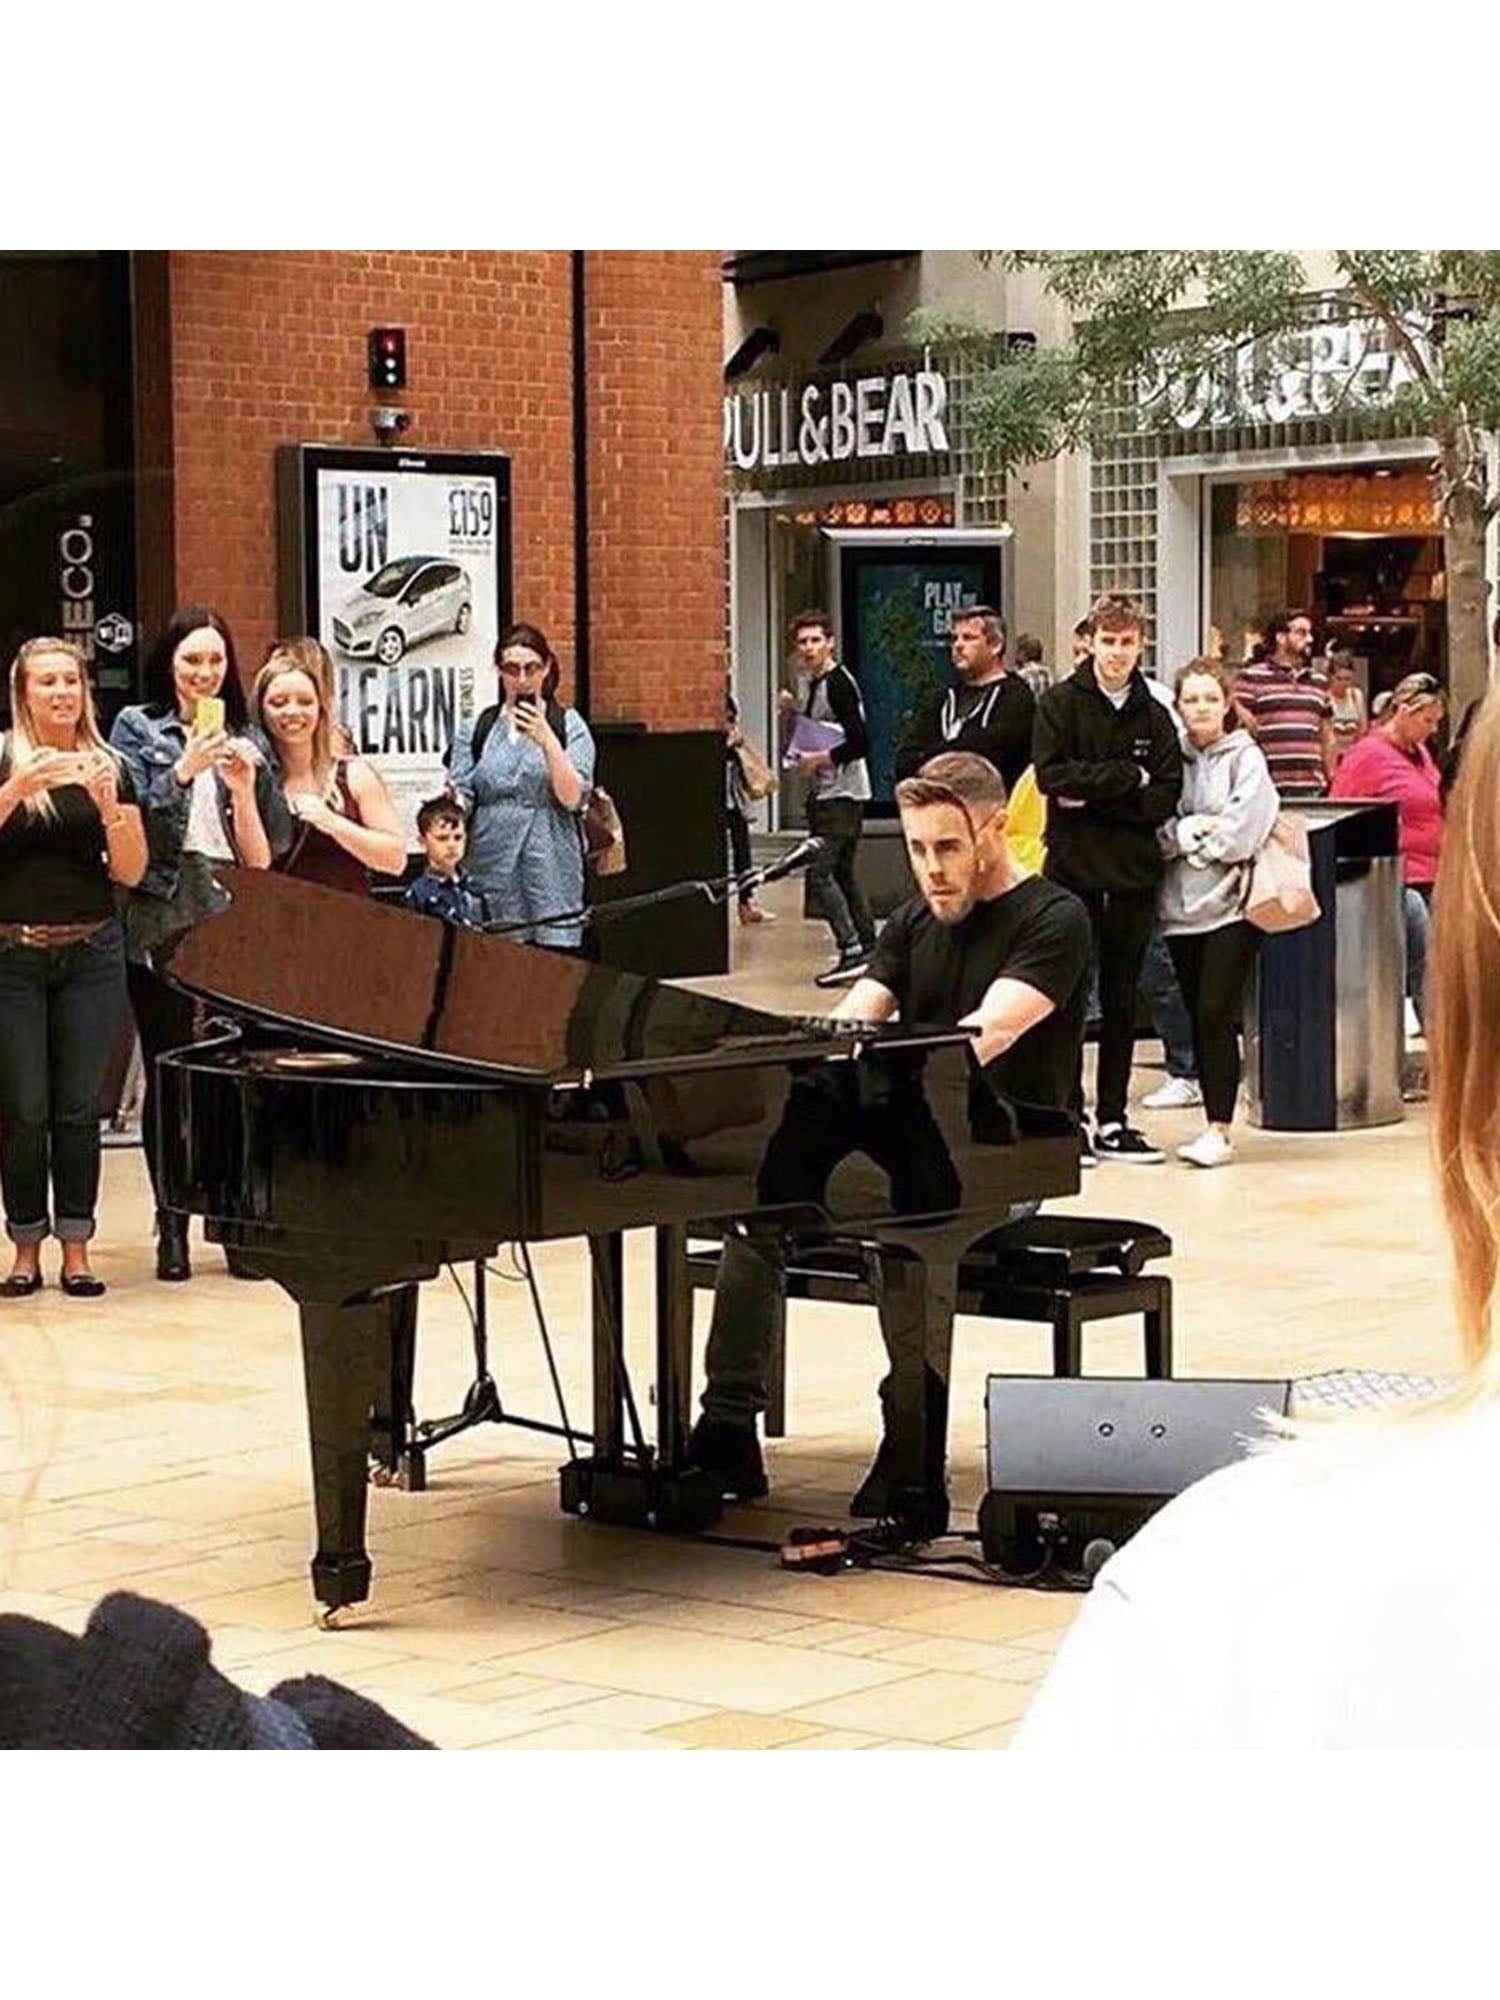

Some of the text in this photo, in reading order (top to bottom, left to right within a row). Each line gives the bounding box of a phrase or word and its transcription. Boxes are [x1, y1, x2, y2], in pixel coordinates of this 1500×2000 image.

[338, 484, 389, 573] UN
[448, 489, 493, 537] £159
[924, 582, 962, 609] PLAY
